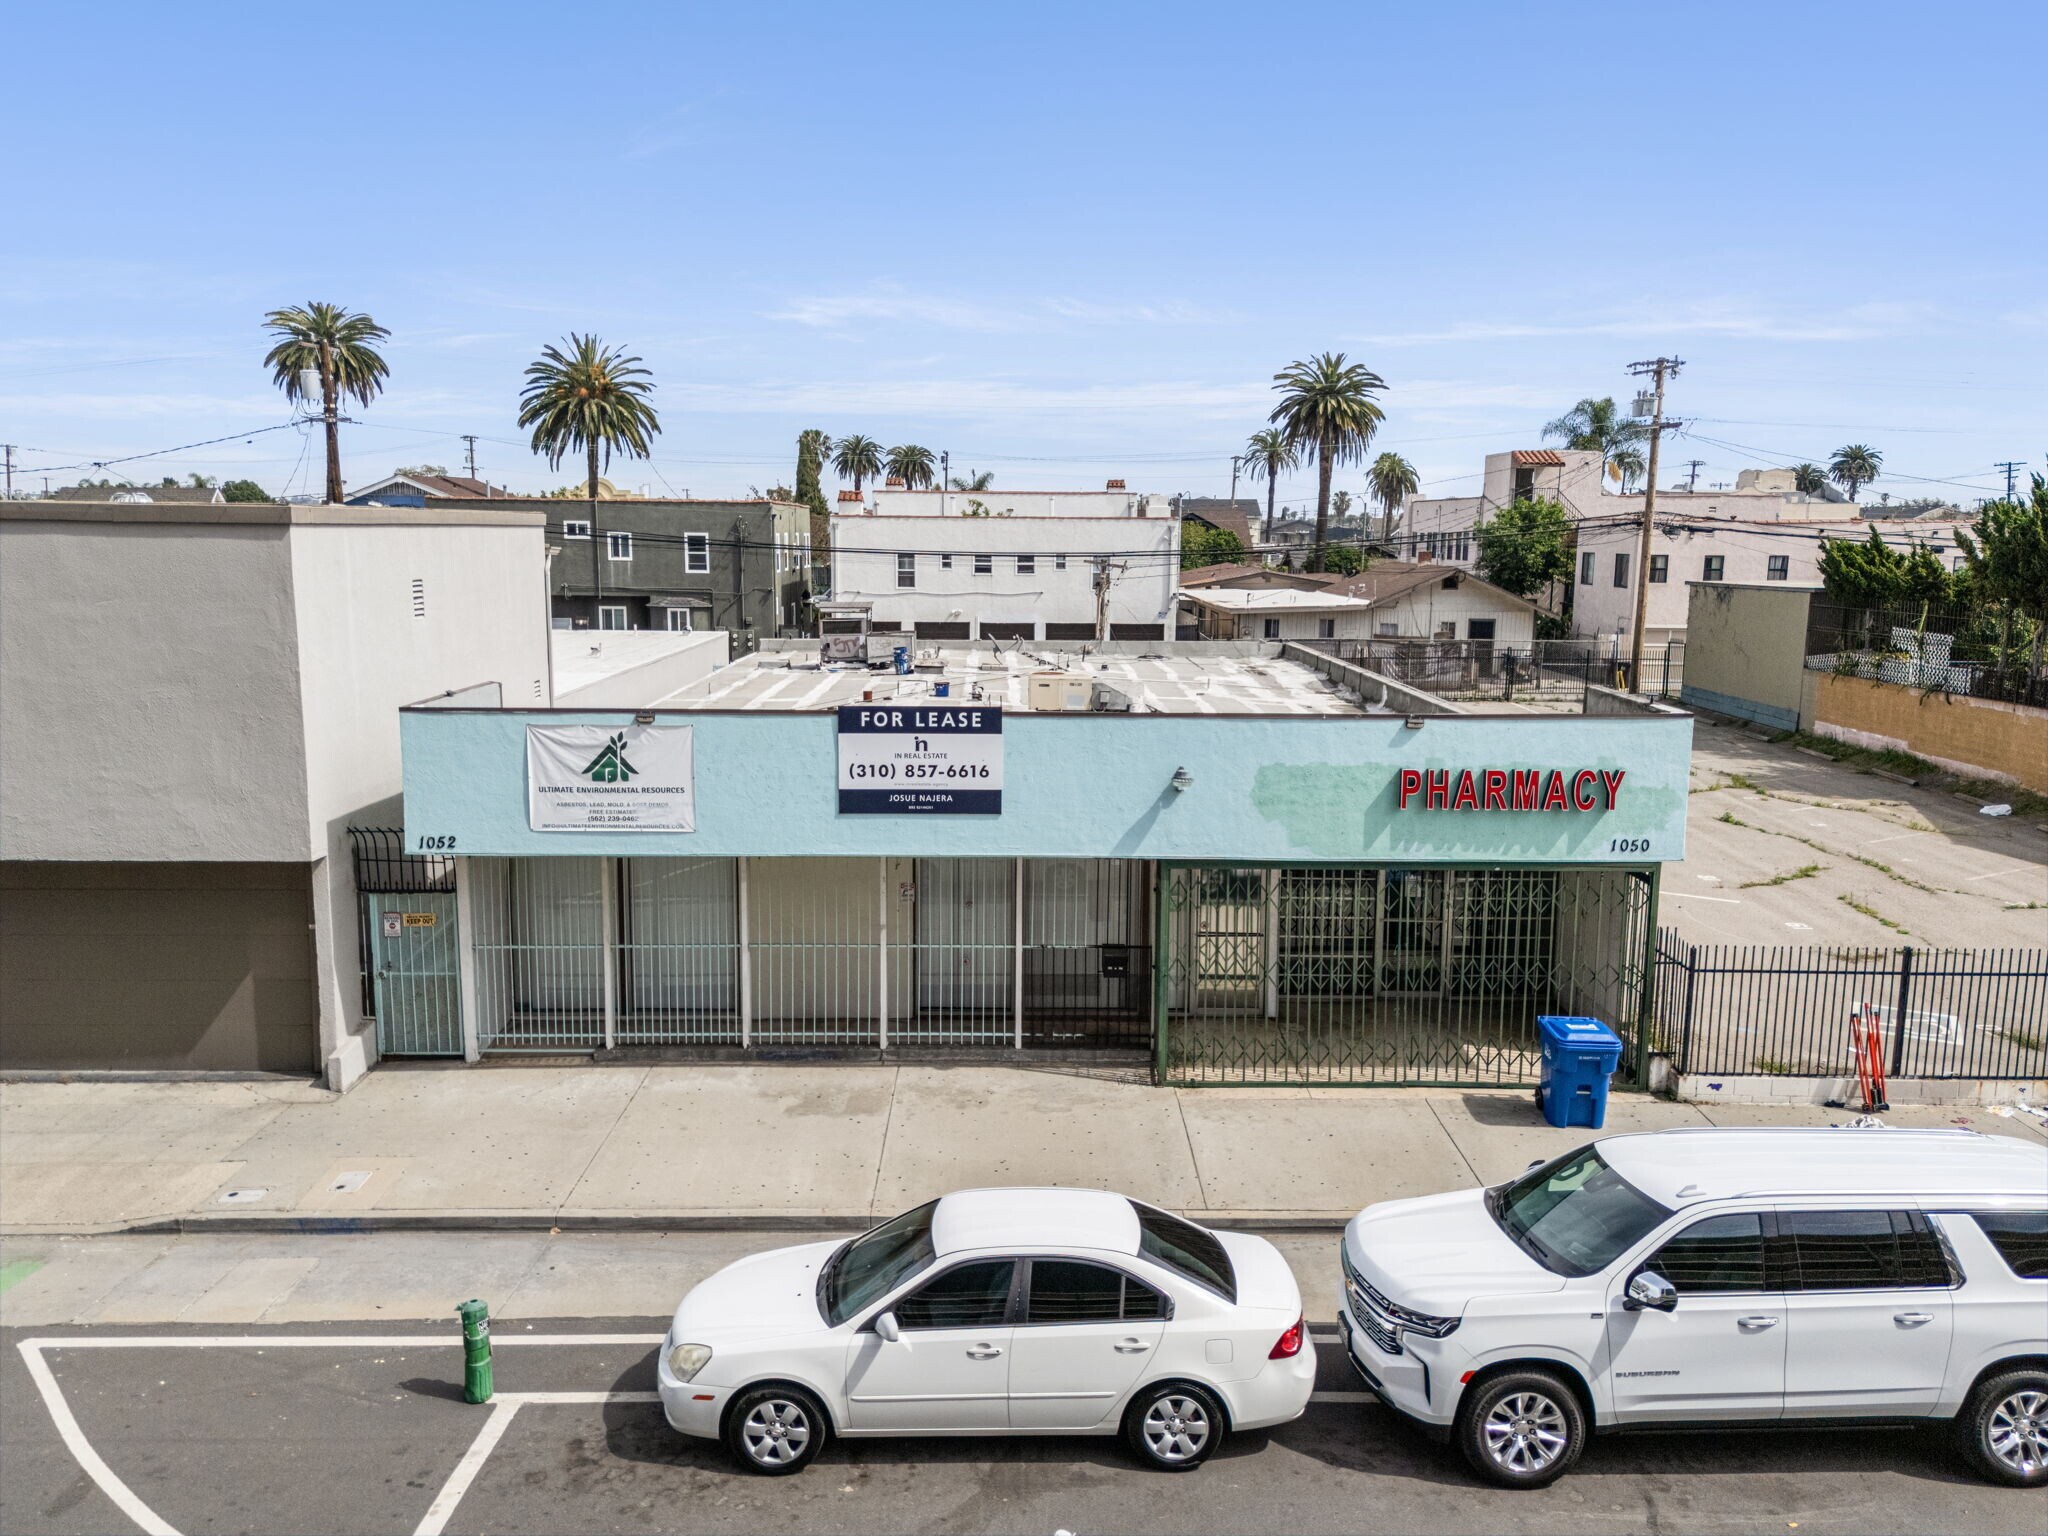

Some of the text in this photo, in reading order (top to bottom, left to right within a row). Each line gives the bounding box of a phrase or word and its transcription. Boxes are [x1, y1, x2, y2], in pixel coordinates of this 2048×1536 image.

[860, 711, 982, 728] FOR LEASE
[894, 752, 948, 760] IN REAL ESTATE
[849, 763, 990, 780] (310) 857-6616
[576, 786, 640, 794] ENVIRONMENTAL
[1399, 768, 1626, 812] PHARMACY
[889, 794, 953, 802] JOSUE NAJERA
[419, 836, 456, 849] 1052
[1610, 838, 1650, 853] 1050
